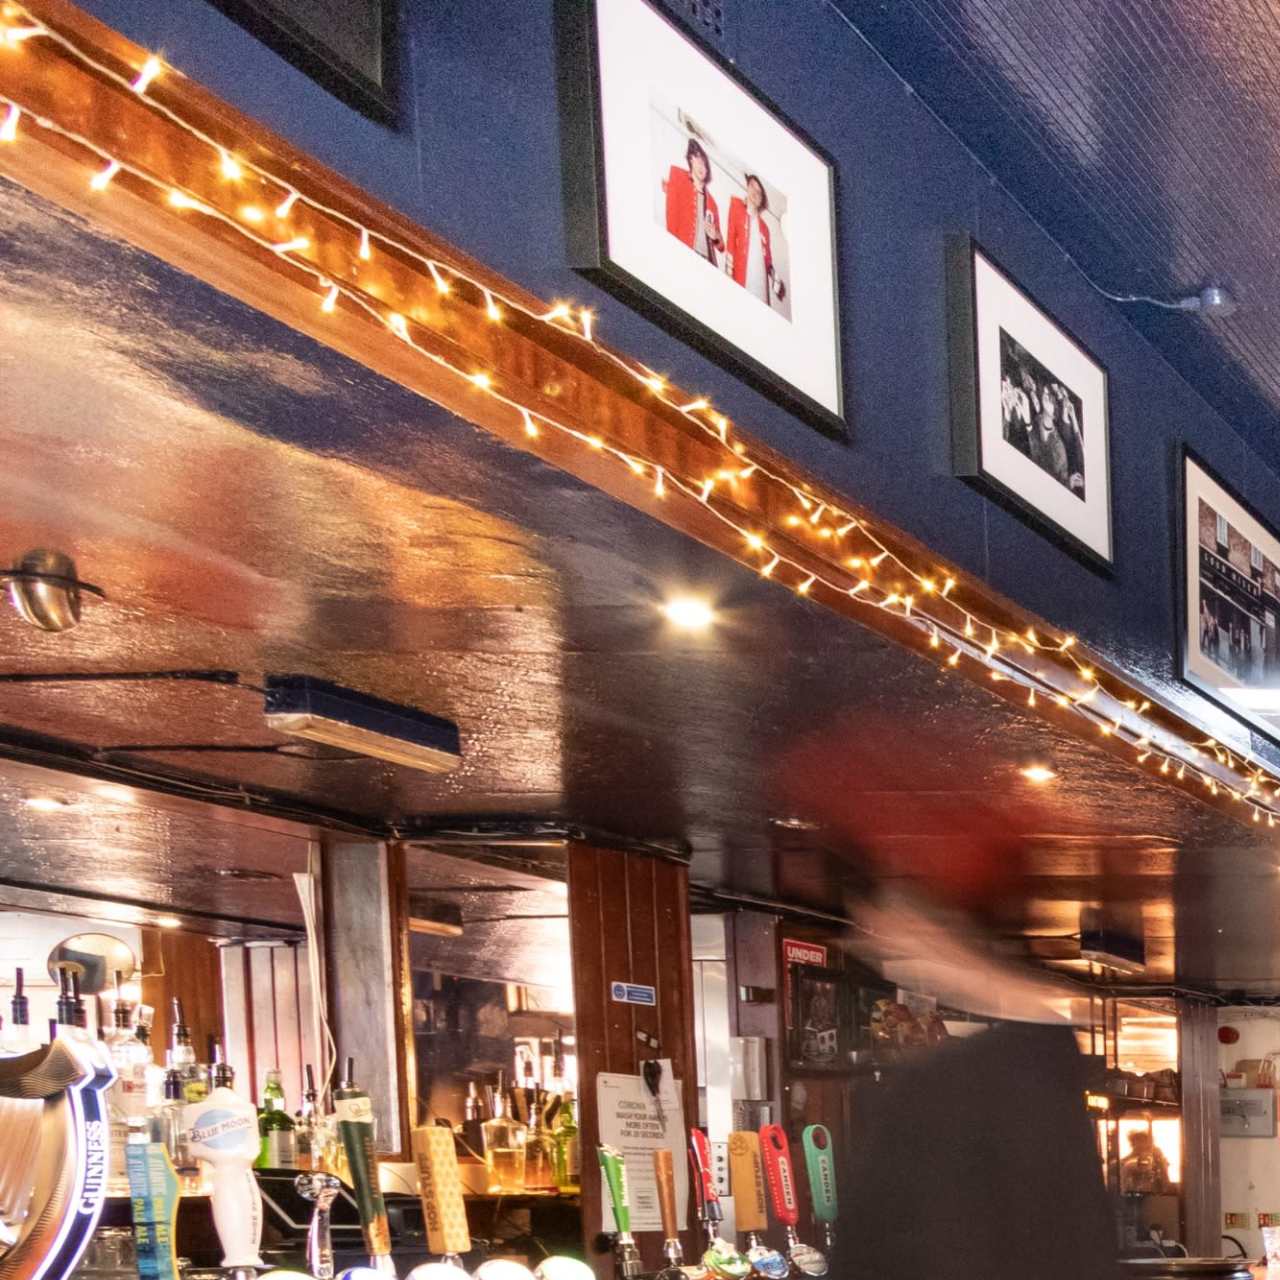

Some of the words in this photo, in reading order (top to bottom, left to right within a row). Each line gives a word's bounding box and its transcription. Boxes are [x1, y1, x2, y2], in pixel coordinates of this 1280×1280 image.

[787, 946, 823, 963] UNDER
[79, 1121, 105, 1215] GUINNESS
[417, 1152, 435, 1200] STUFF
[780, 1160, 793, 1206] CAMDEN
[821, 1158, 832, 1203] CAMDEN
[427, 1201, 439, 1232] HOP
